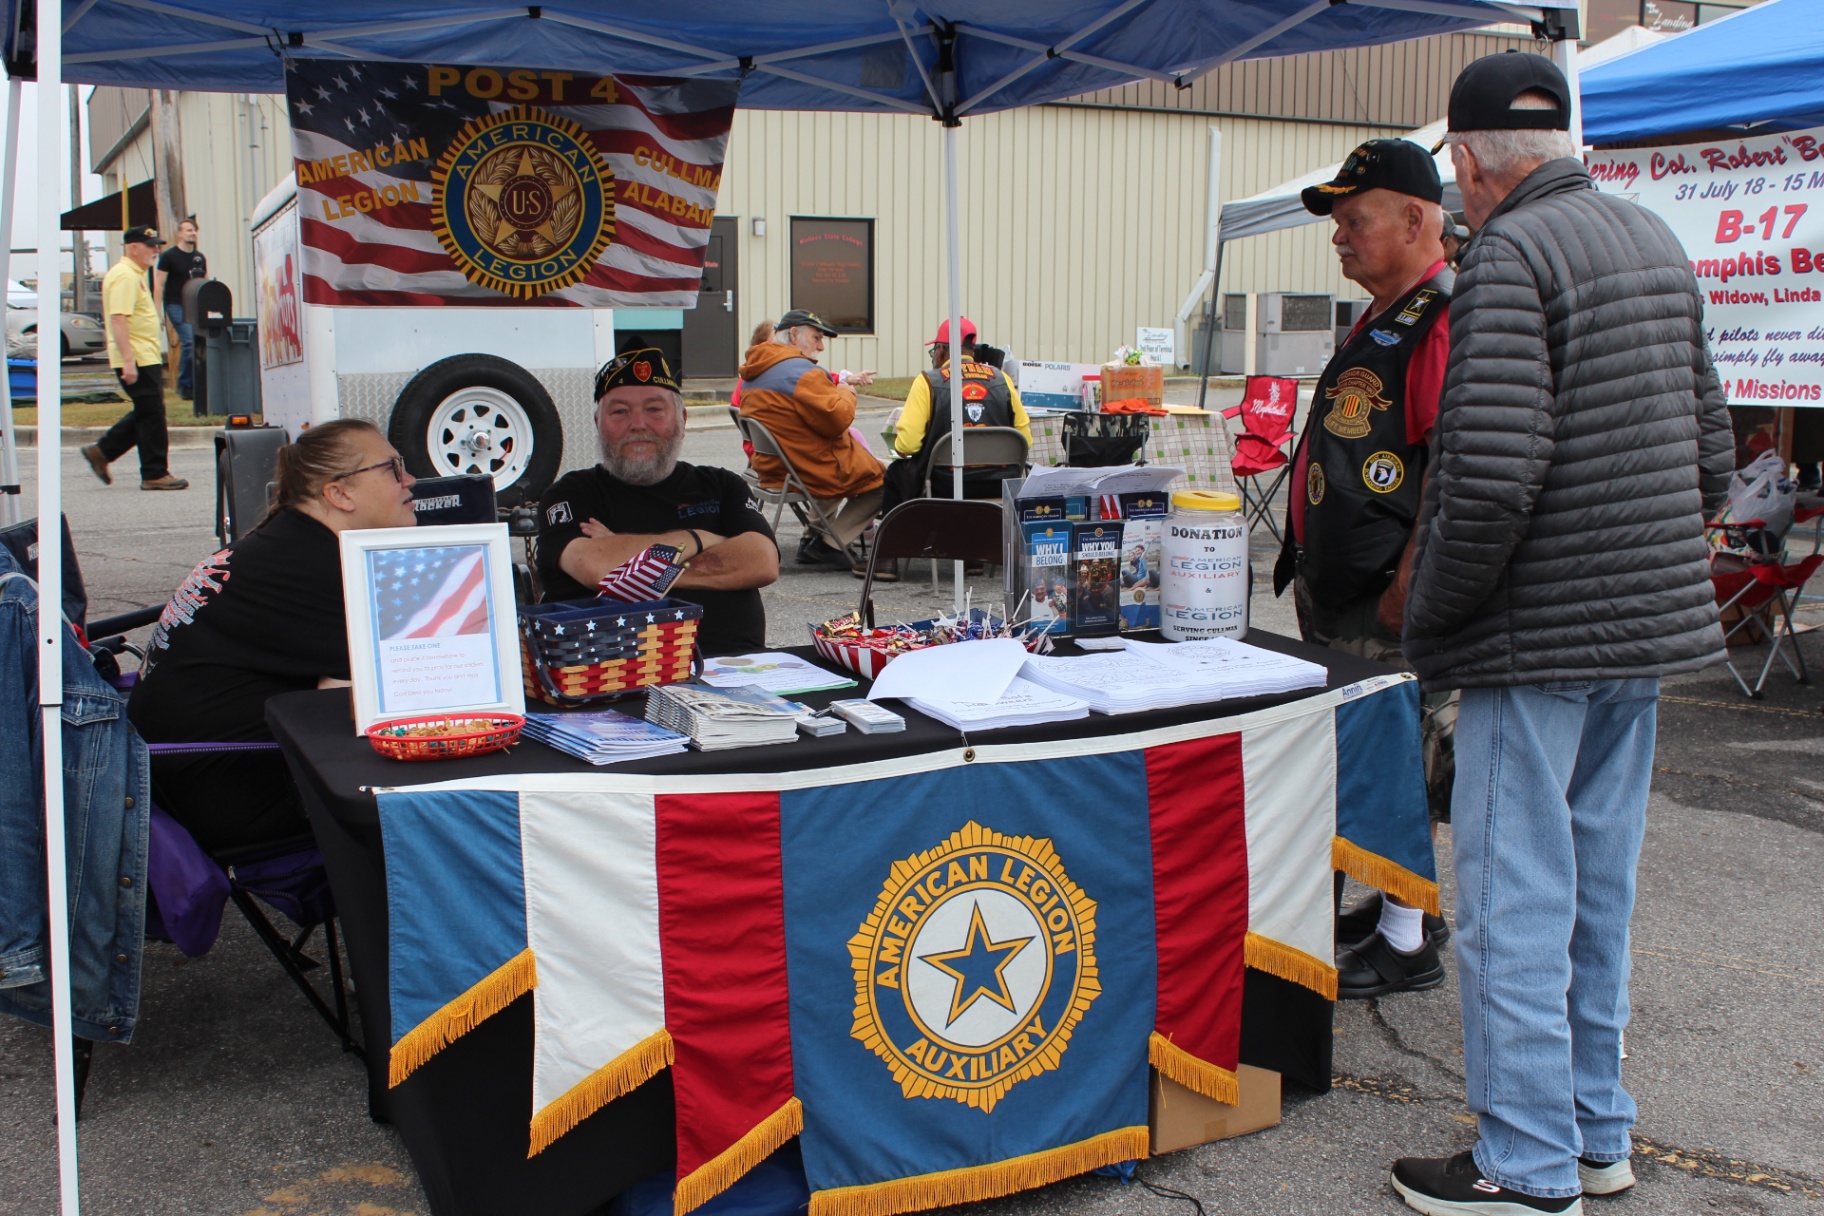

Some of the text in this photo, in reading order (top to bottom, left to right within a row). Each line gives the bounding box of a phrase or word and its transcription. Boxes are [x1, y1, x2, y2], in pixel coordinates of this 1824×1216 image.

[427, 65, 619, 104] POST 4
[298, 136, 430, 187] AMERICAN
[456, 124, 595, 185] AMERICAN
[1650, 151, 1697, 181] Col.
[1701, 144, 1788, 173] Robert
[633, 146, 720, 192] CULLMA
[1675, 183, 1697, 201] 31
[1700, 180, 1739, 201] July
[1743, 177, 1764, 195] 18
[1783, 173, 1806, 192] 15
[321, 180, 420, 222] LEGION
[623, 181, 714, 228] ALABAM
[1714, 203, 1808, 244] B-17
[472, 247, 578, 280] LEGION
[1709, 290, 1769, 306] Widow,
[1774, 287, 1821, 303] Linda
[1718, 326, 1760, 345] pilots
[1765, 331, 1802, 342] never
[1044, 363, 1071, 371] POLARIS
[1713, 348, 1760, 367] simply
[1760, 347, 1784, 368] fly
[1360, 371, 1380, 388] GUARD
[1735, 379, 1822, 400] Missions
[1339, 425, 1365, 435] MEMBER
[1171, 526, 1243, 540] DONATION
[1036, 543, 1063, 555] WHY I
[1081, 541, 1116, 552] WHY YOU
[1036, 555, 1063, 566] BELONG
[1170, 560, 1241, 571] LEGION
[1170, 571, 1241, 579] AUXILIARY
[1165, 608, 1243, 621] LEGION
[1186, 604, 1243, 613] AMERICAN
[1173, 625, 1206, 634] SERVING
[389, 644, 410, 652] PLEASE
[876, 854, 1076, 990] AMERICAN LEGION
[903, 1014, 1049, 1081] AUXILIARY
